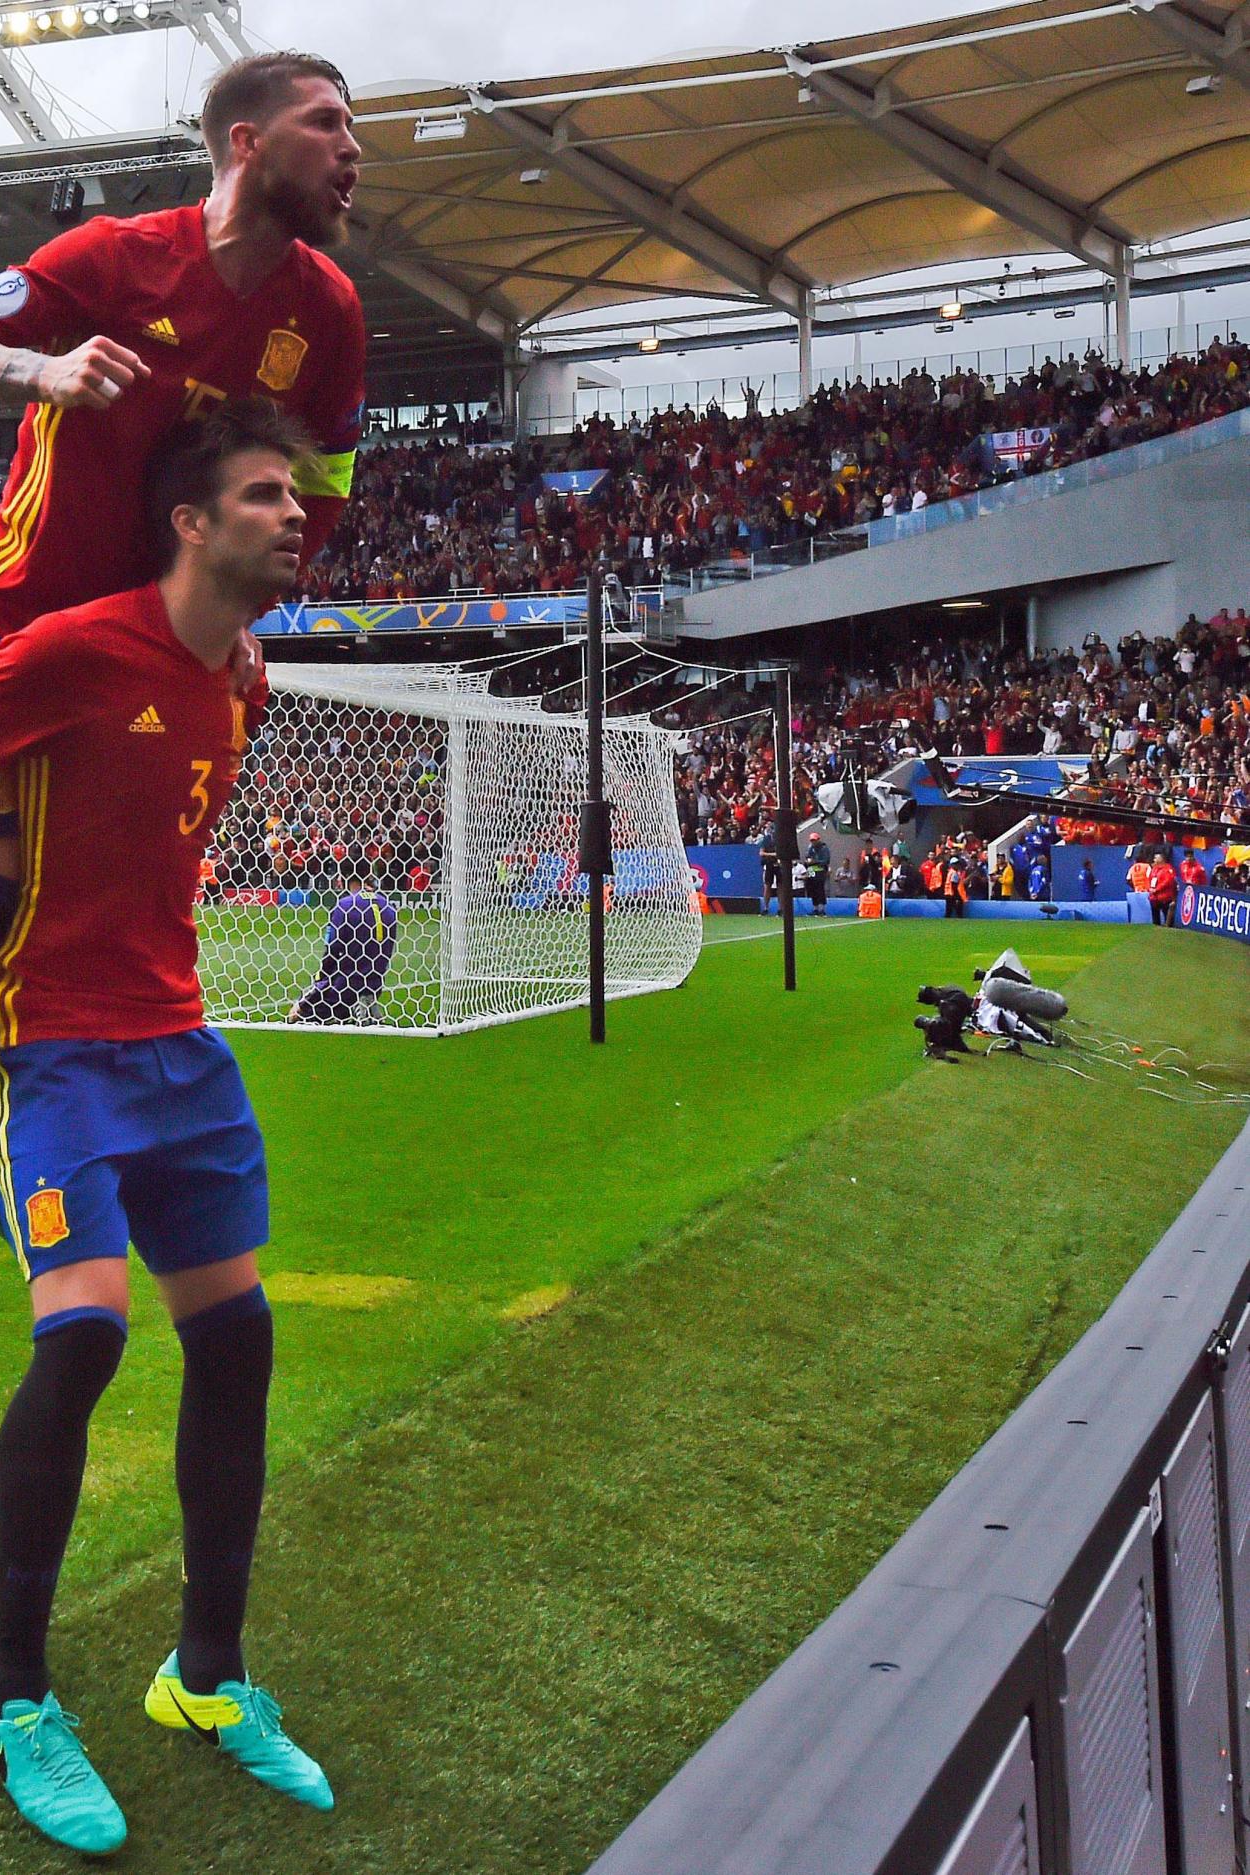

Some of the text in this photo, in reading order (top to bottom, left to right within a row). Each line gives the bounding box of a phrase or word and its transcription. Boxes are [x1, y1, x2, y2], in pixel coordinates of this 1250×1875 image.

[129, 723, 165, 733] adidas
[179, 760, 213, 835] 3
[1196, 892, 1250, 936] RESPECT
